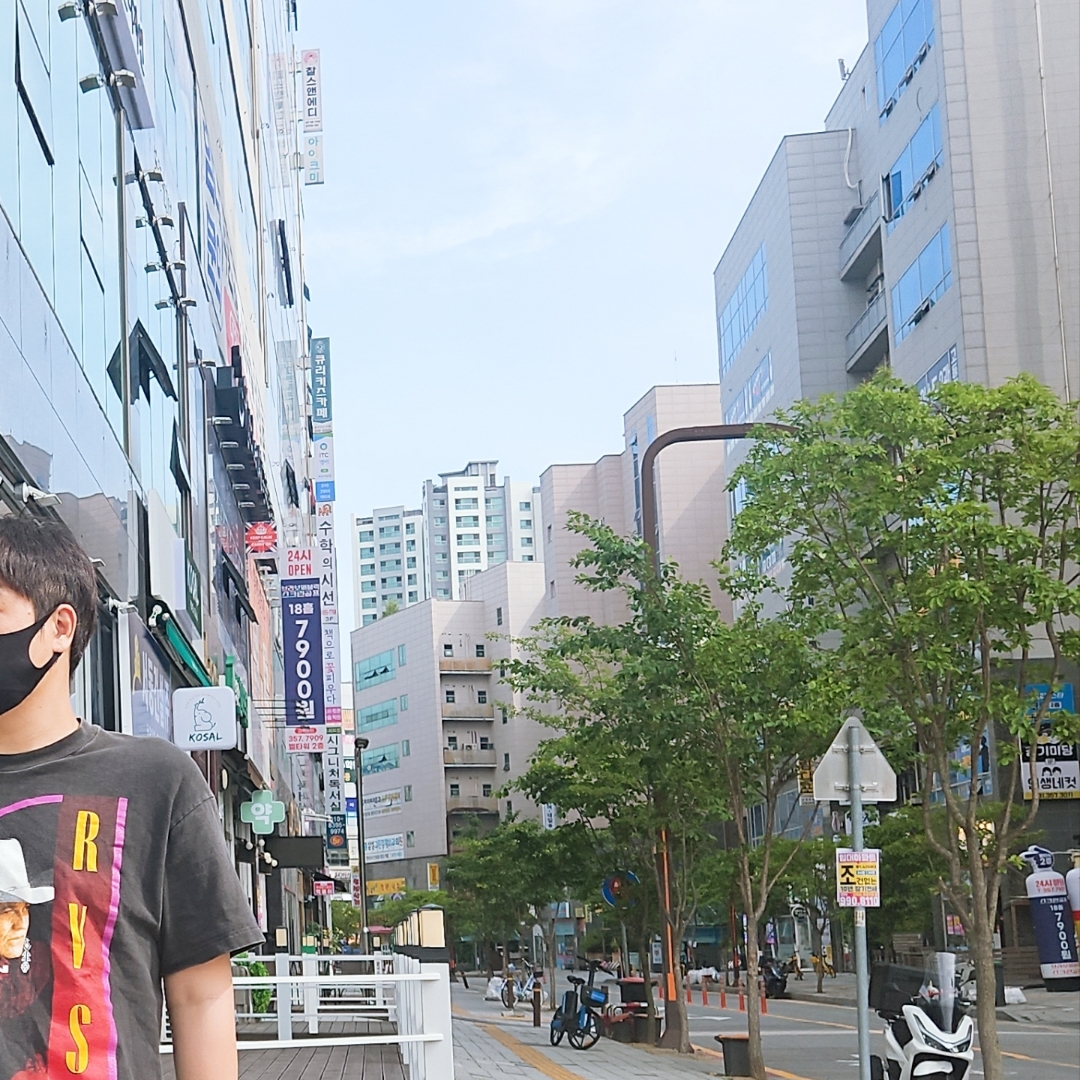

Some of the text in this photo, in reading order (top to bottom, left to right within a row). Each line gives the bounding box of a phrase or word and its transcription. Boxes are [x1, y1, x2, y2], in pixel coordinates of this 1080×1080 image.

[306, 66, 317, 117] 찰스앤에디
[314, 354, 328, 419] 큐리키즈카페
[287, 549, 311, 562] 24시
[288, 564, 312, 576] OPEN
[288, 603, 314, 615] 18홀
[188, 732, 223, 743] KOSAL
[327, 736, 341, 811] 시그니처독서실
[250, 802, 273, 825] 약
[1055, 912, 1072, 960] 7900원
